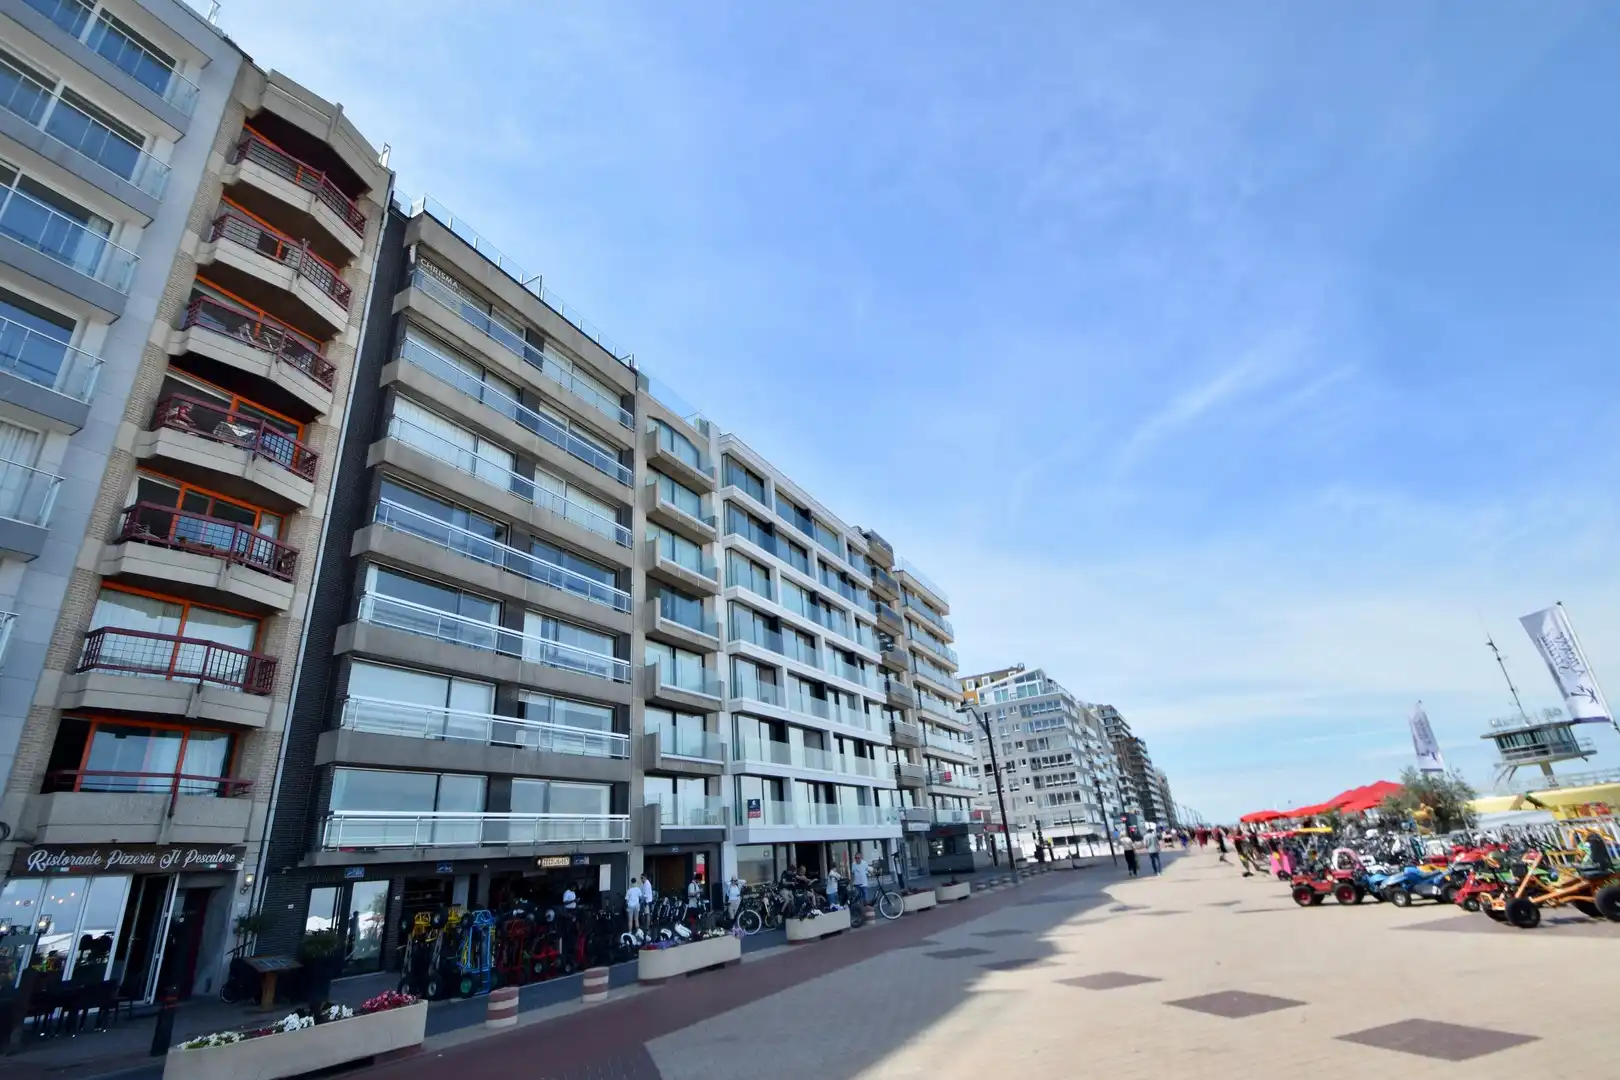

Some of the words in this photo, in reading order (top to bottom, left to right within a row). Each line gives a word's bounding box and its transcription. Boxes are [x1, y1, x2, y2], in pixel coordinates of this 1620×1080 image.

[27, 849, 102, 872] Ristorante
[104, 849, 156, 870] Pizzeria
[182, 848, 236, 868] Pescatore
